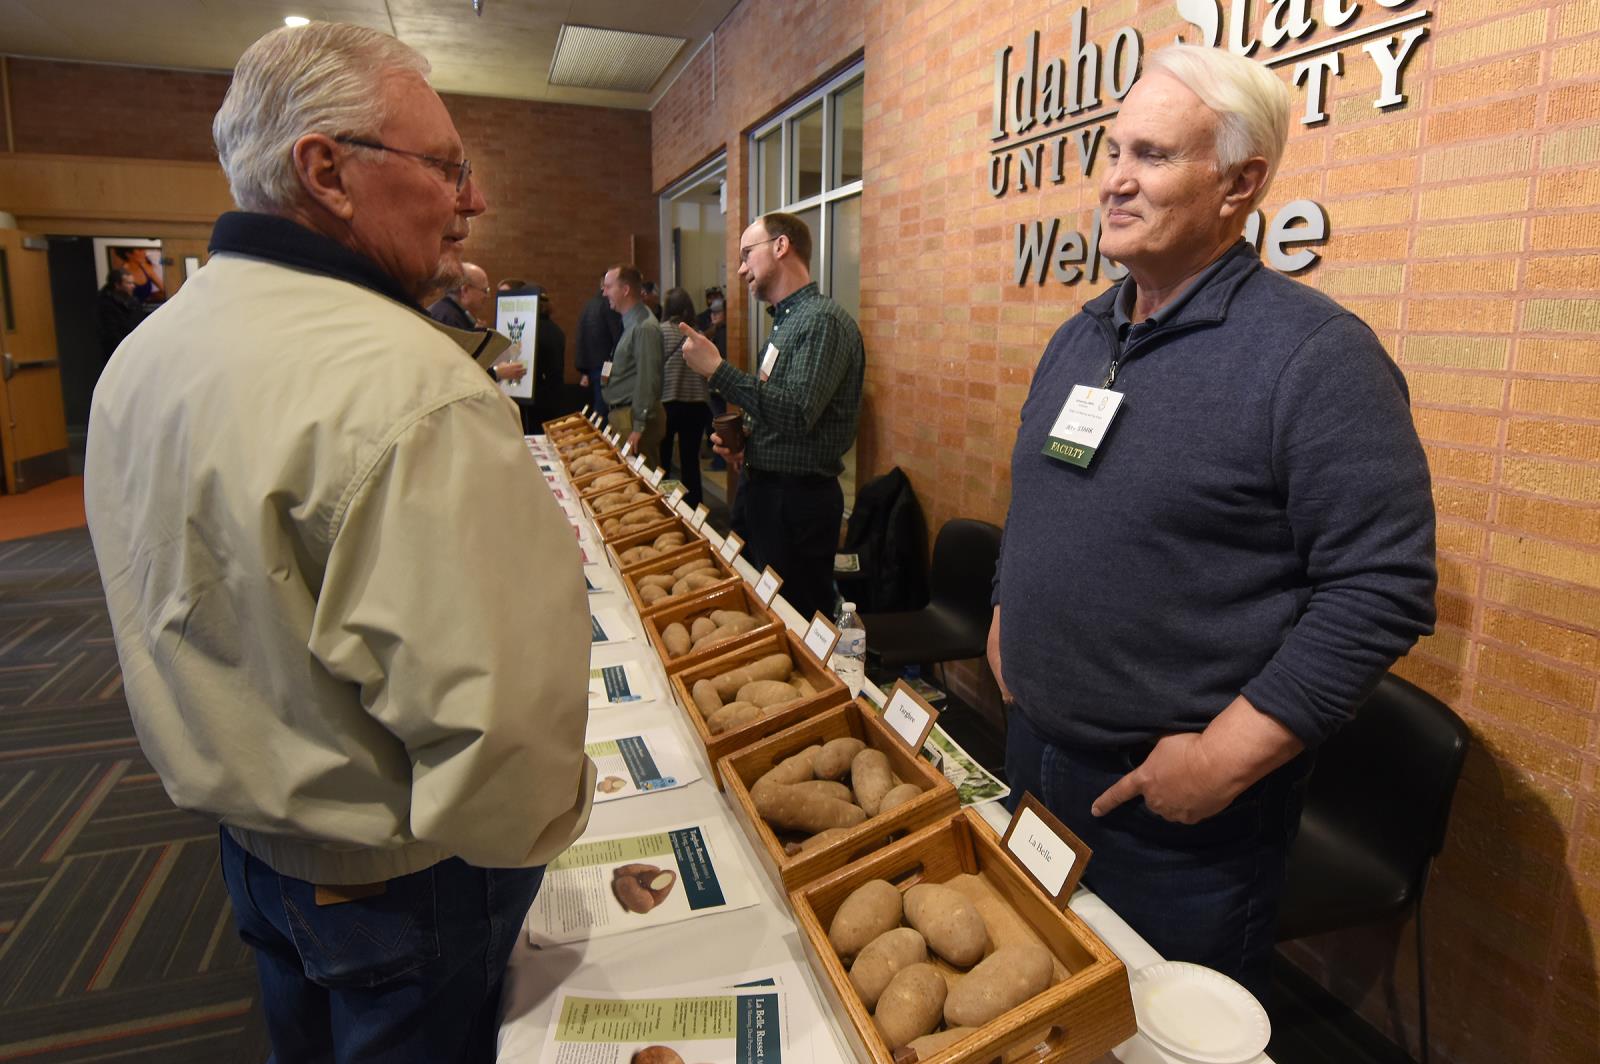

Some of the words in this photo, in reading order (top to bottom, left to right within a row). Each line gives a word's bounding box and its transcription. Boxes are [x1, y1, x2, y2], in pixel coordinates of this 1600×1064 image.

[990, 6, 1143, 141] Idaho
[1175, 0, 1420, 57] Sta
[987, 27, 1426, 197] UNIVTY
[1013, 199, 1325, 285] Wele
[1050, 441, 1085, 459] FACULTY
[898, 704, 917, 724] Targhee
[1028, 835, 1036, 848] La
[1036, 844, 1052, 862] Belle
[756, 998, 764, 1008] La
[756, 1010, 764, 1029] Belle
[756, 1030, 765, 1057] Russet
